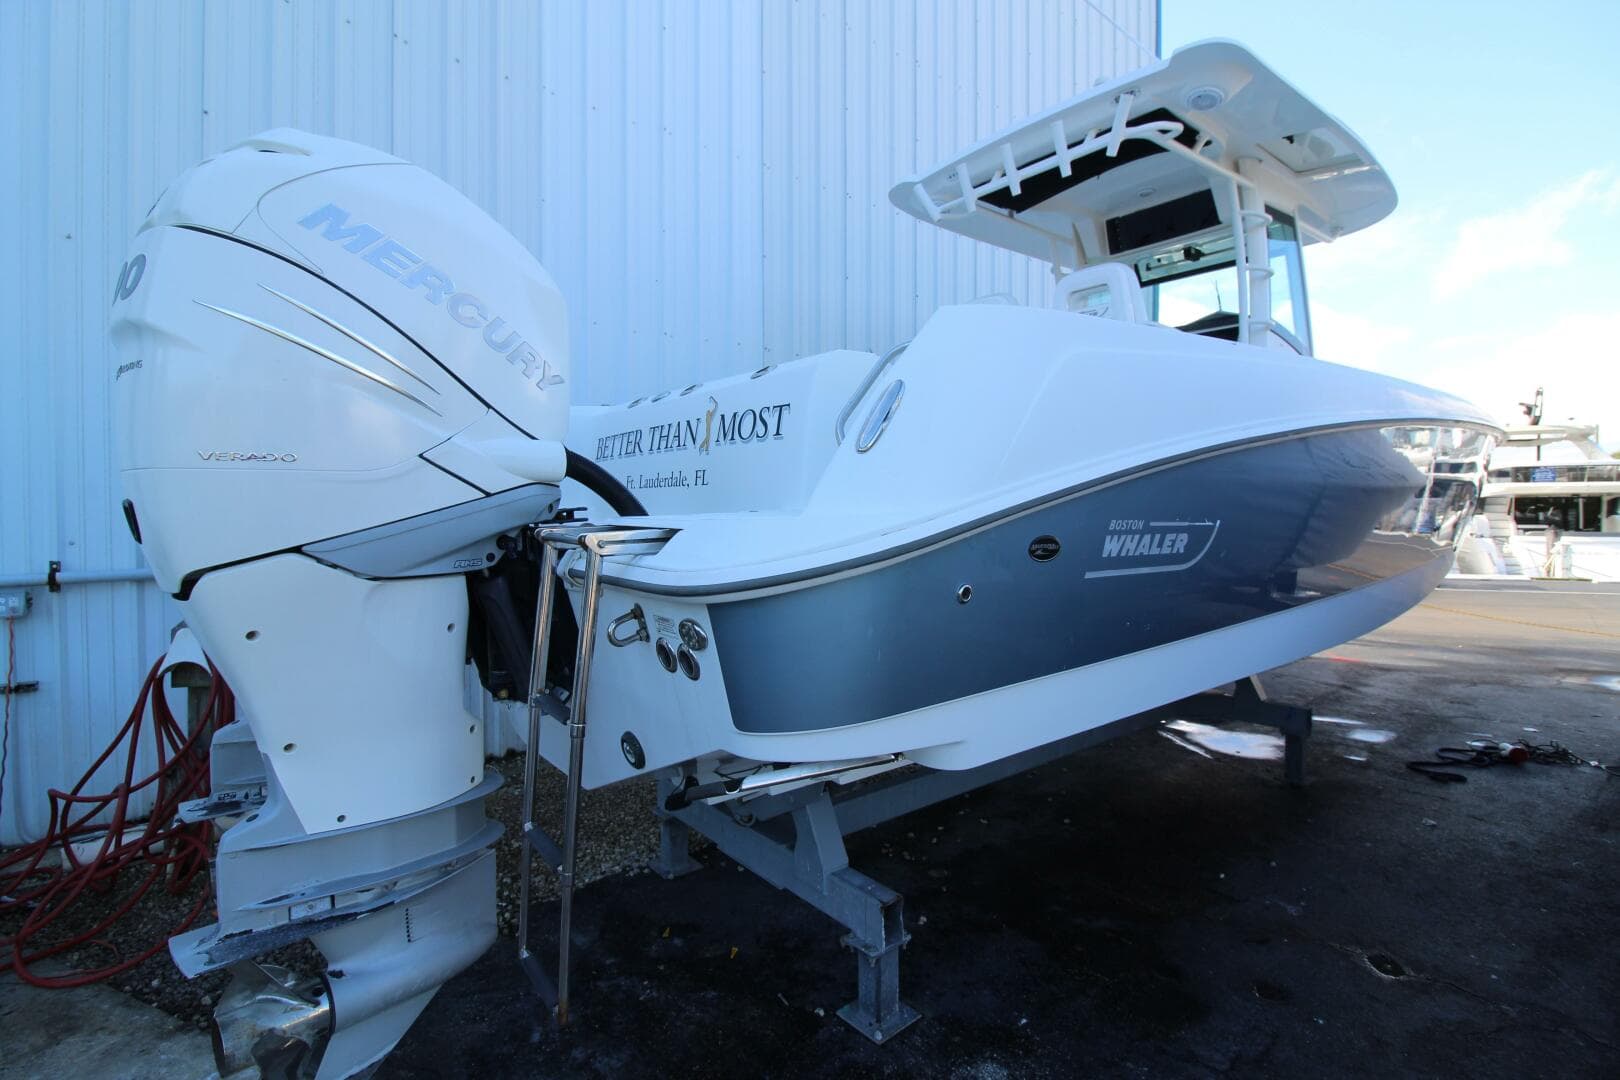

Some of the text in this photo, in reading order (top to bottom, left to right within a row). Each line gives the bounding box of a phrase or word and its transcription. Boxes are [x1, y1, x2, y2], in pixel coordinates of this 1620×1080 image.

[297, 203, 565, 391] MERCURY
[596, 403, 790, 461] BETTER THAN MOST
[198, 450, 298, 463] VERADO
[626, 469, 709, 490] Ft. Lauderdale, FL
[1108, 519, 1145, 531] BOSTON
[1102, 533, 1188, 558] WHALER
